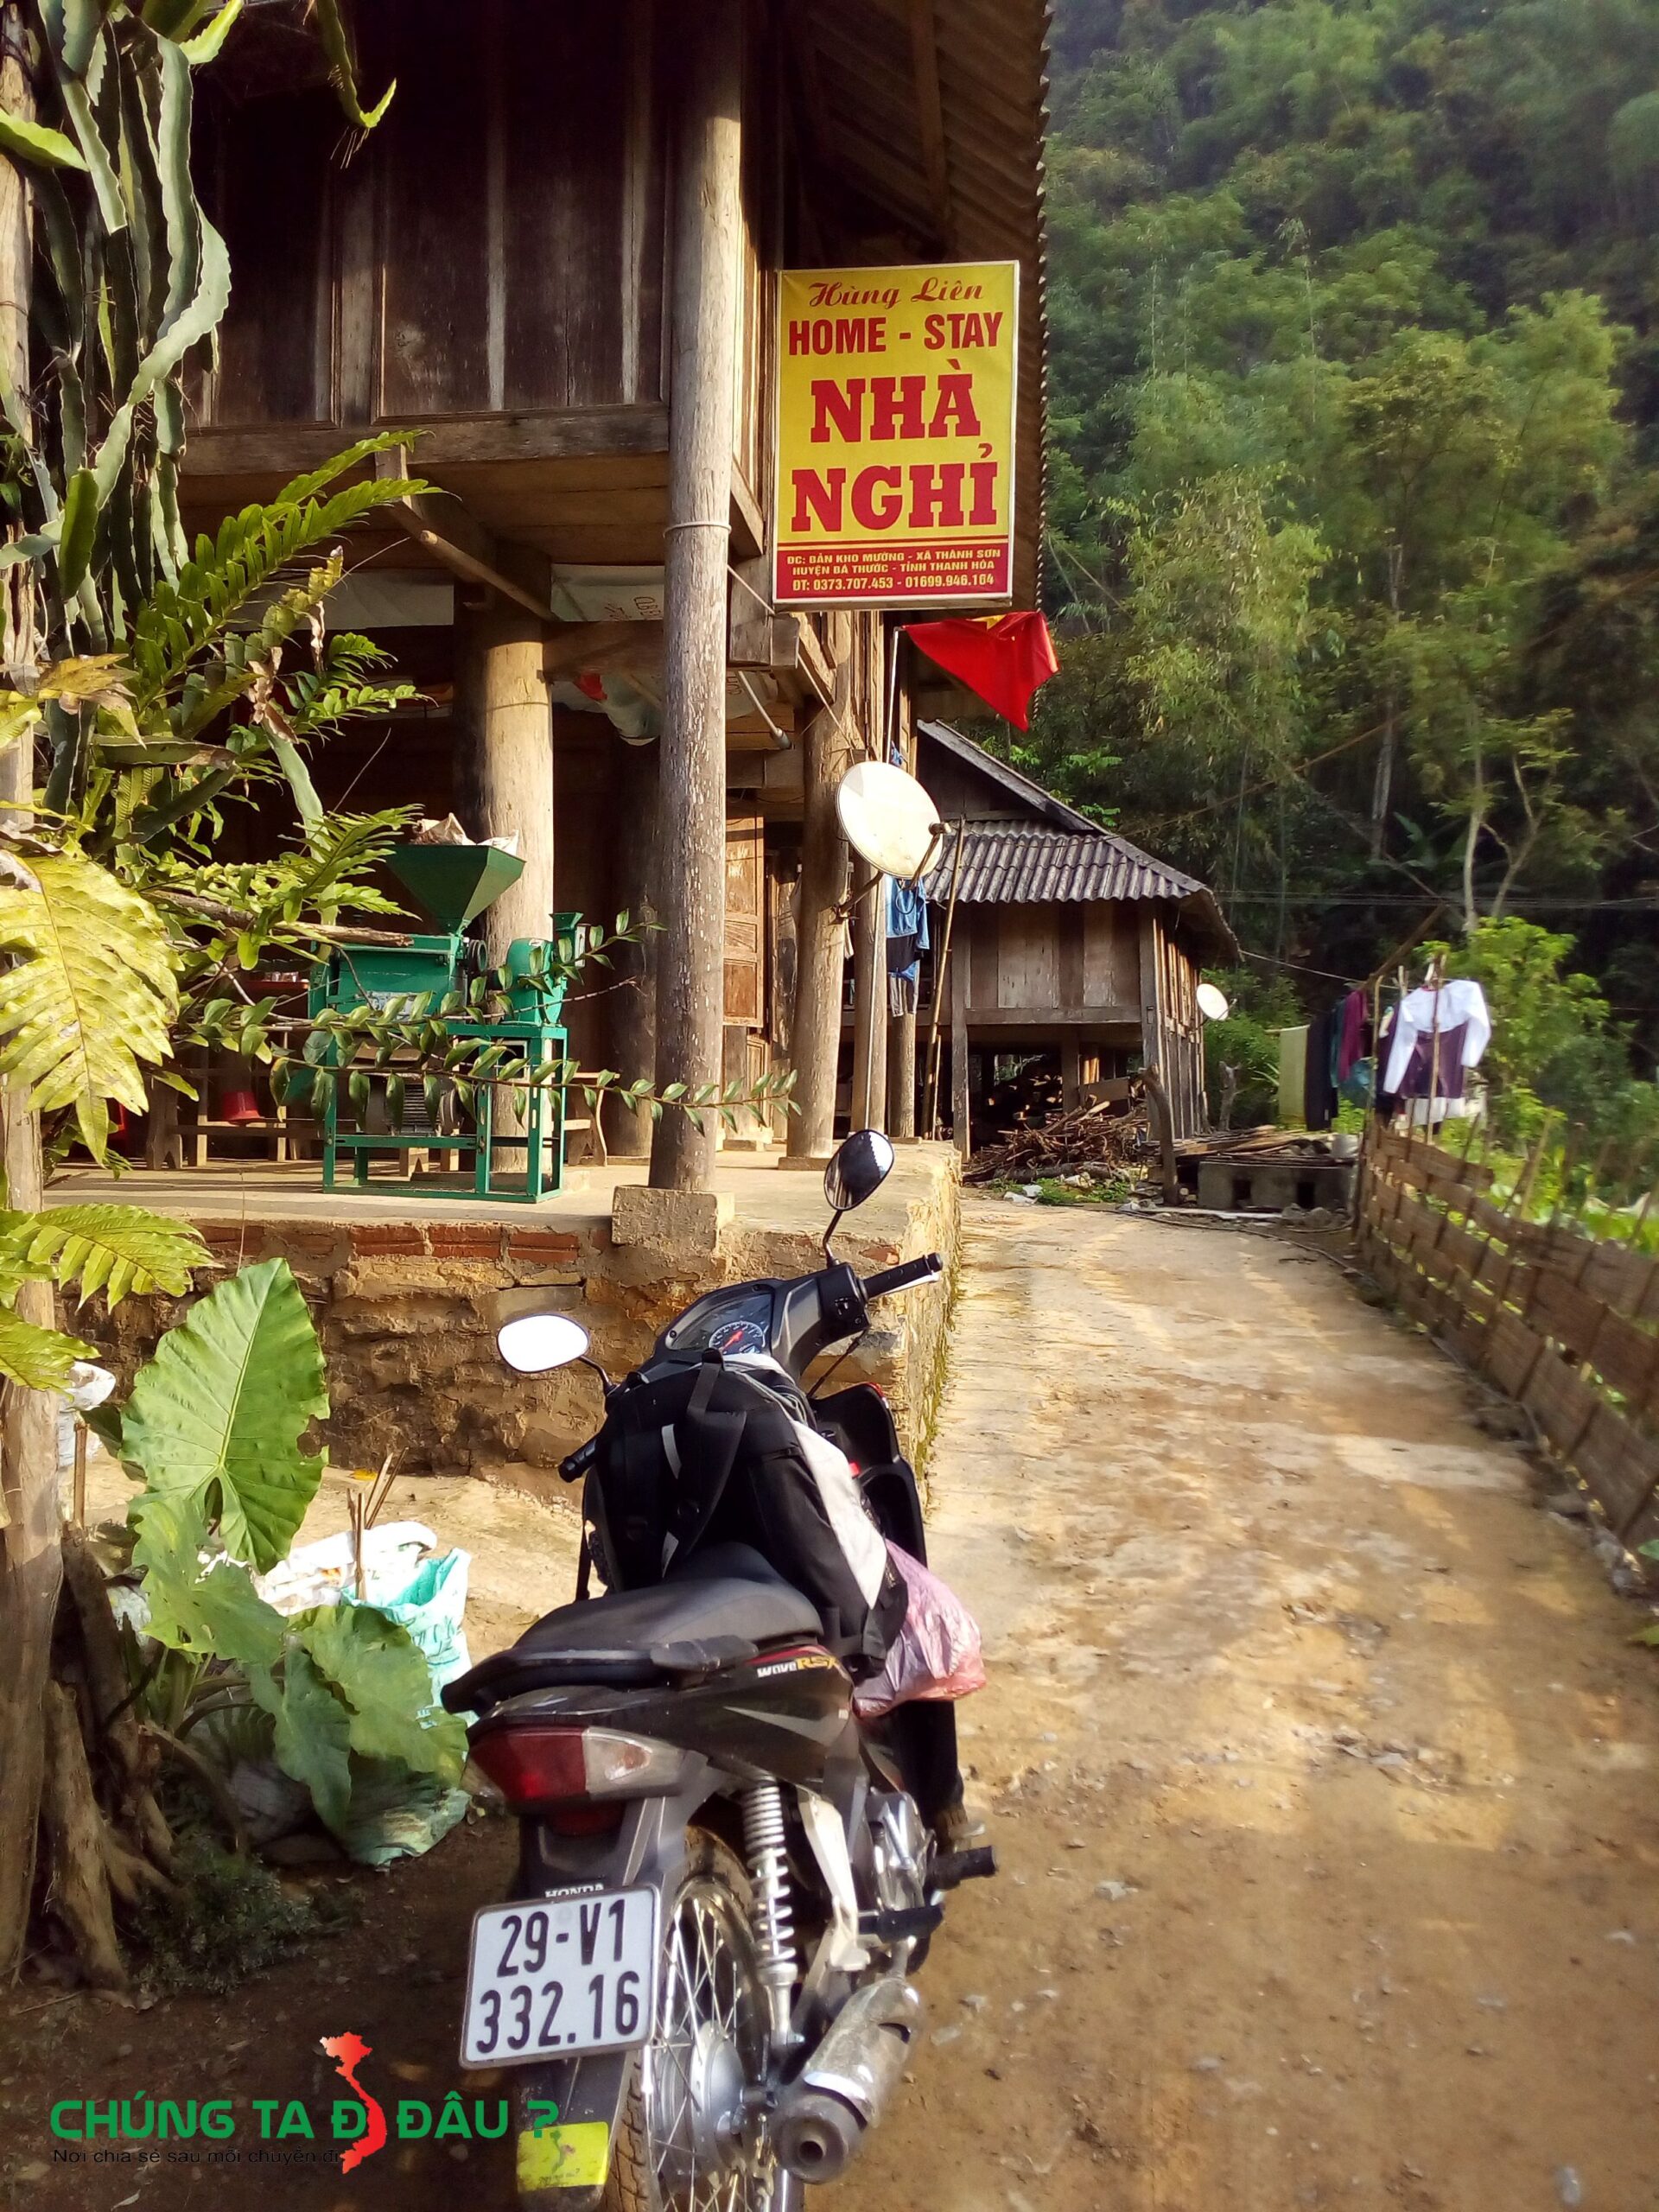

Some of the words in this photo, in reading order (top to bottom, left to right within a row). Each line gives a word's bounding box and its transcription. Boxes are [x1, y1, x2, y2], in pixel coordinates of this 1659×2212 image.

[809, 281, 900, 309] Hùng
[911, 276, 983, 302] Liên
[789, 317, 887, 355] HOME
[924, 311, 1003, 350] STAY
[810, 359, 981, 442] NHÀ
[791, 442, 998, 532] NGHỈ
[792, 565, 830, 576] HUYỆN
[833, 563, 849, 575] BÁ
[930, 561, 969, 571] THANH
[836, 553, 859, 563] KHO
[976, 549, 1001, 559] SƠN
[813, 577, 893, 591] 0373.707.453
[905, 574, 995, 588] 01699.946.164
[497, 1899, 626, 1978] 29-V1
[476, 1971, 640, 2054] 332.16
